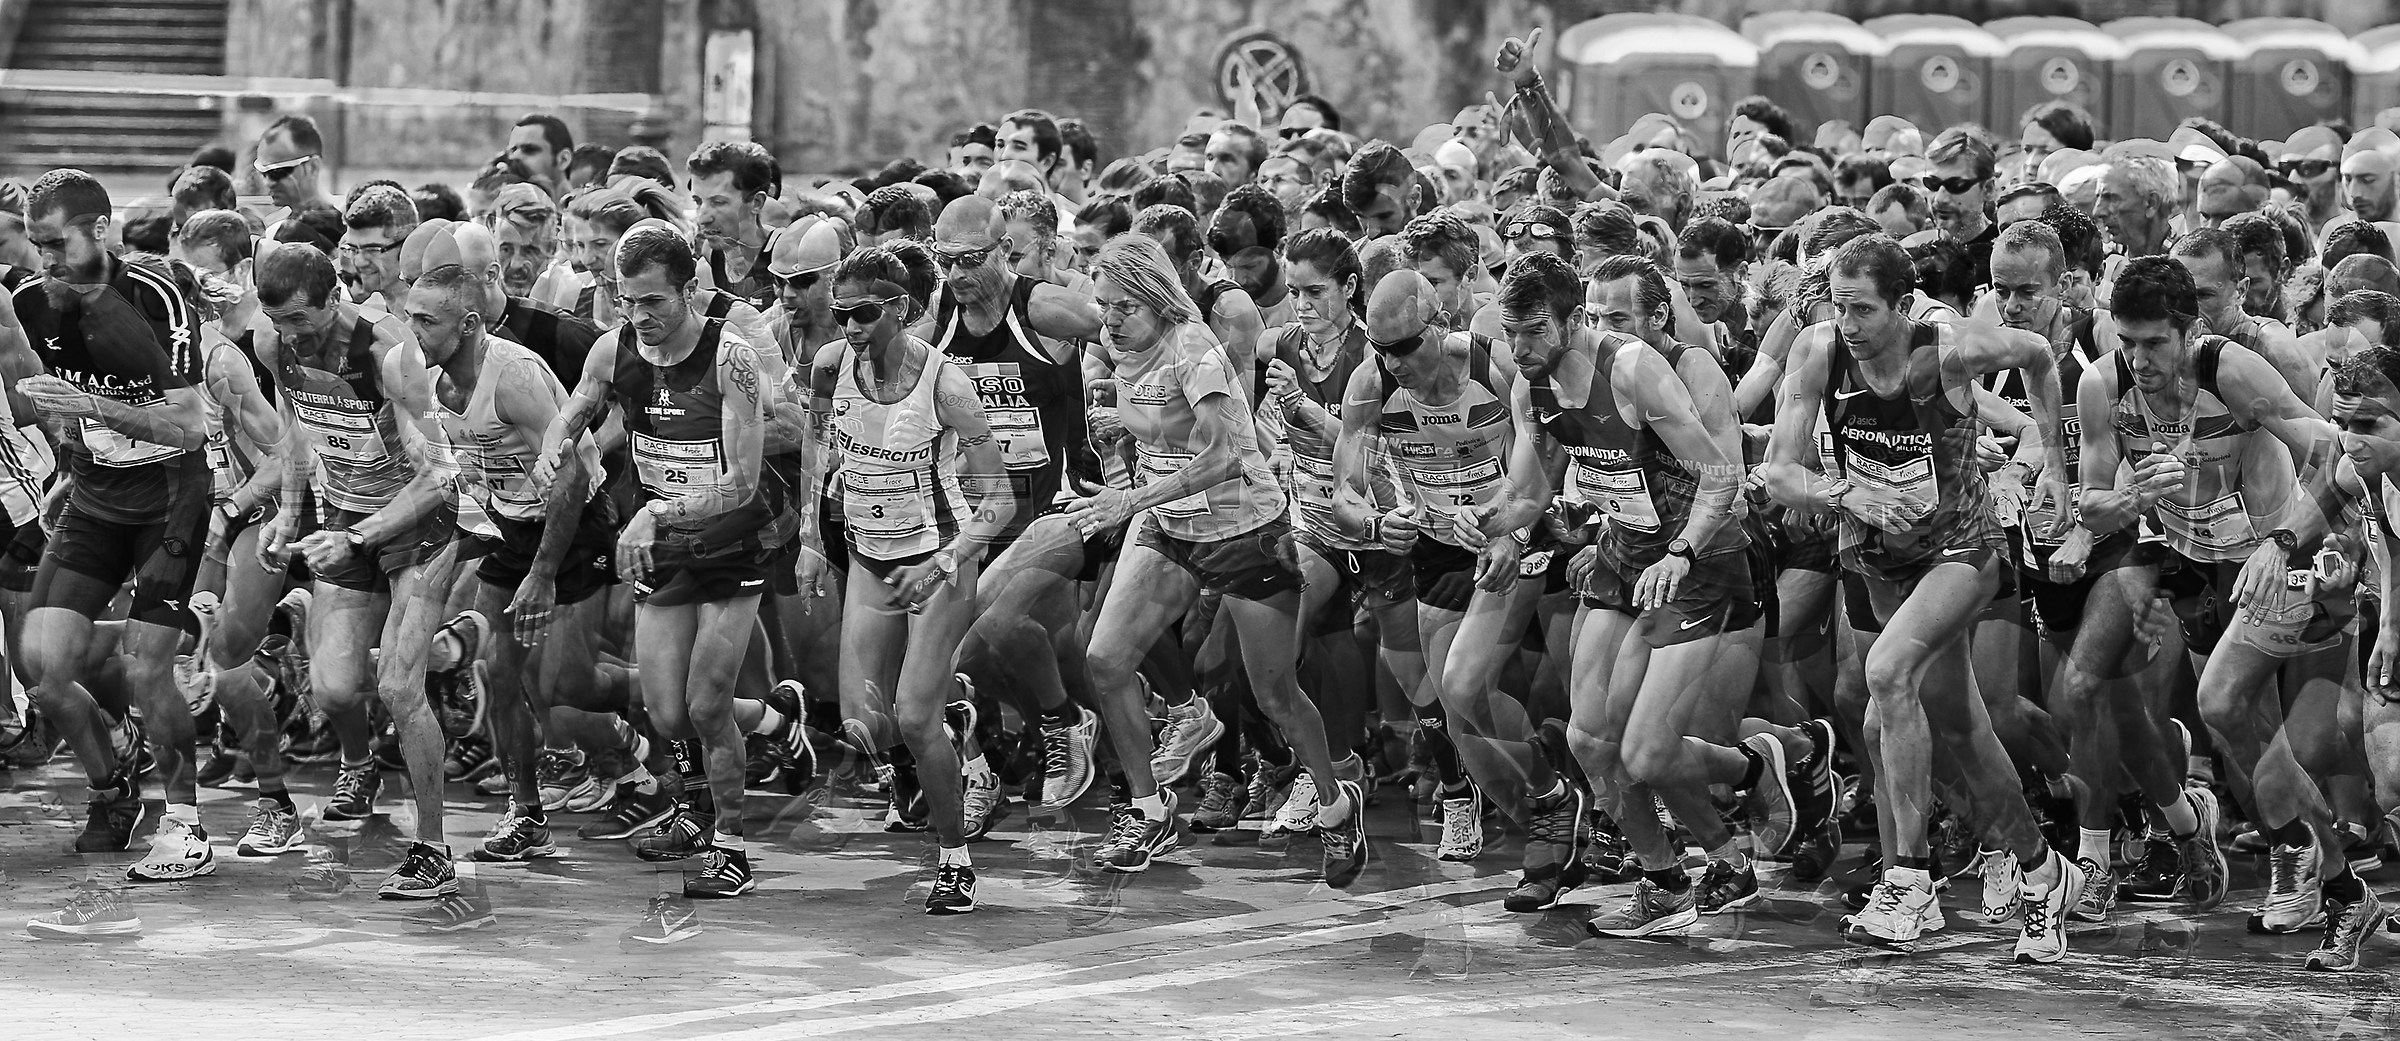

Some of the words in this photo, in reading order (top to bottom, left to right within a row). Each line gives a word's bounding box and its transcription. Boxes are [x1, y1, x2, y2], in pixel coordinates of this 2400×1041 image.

[344, 398, 375, 411] SPORT
[982, 394, 1031, 408] ALIA
[1857, 416, 1878, 427] asics
[327, 434, 351, 451] 85
[1841, 425, 1933, 449] AERONAUTICA
[643, 439, 669, 452] RACE
[851, 443, 930, 463] ESERCITO
[1856, 457, 1883, 474] RACE
[663, 469, 689, 484] 25
[1448, 493, 1476, 507] 72
[1609, 499, 1621, 513] 9
[871, 504, 885, 519] 3
[971, 508, 997, 524] 20
